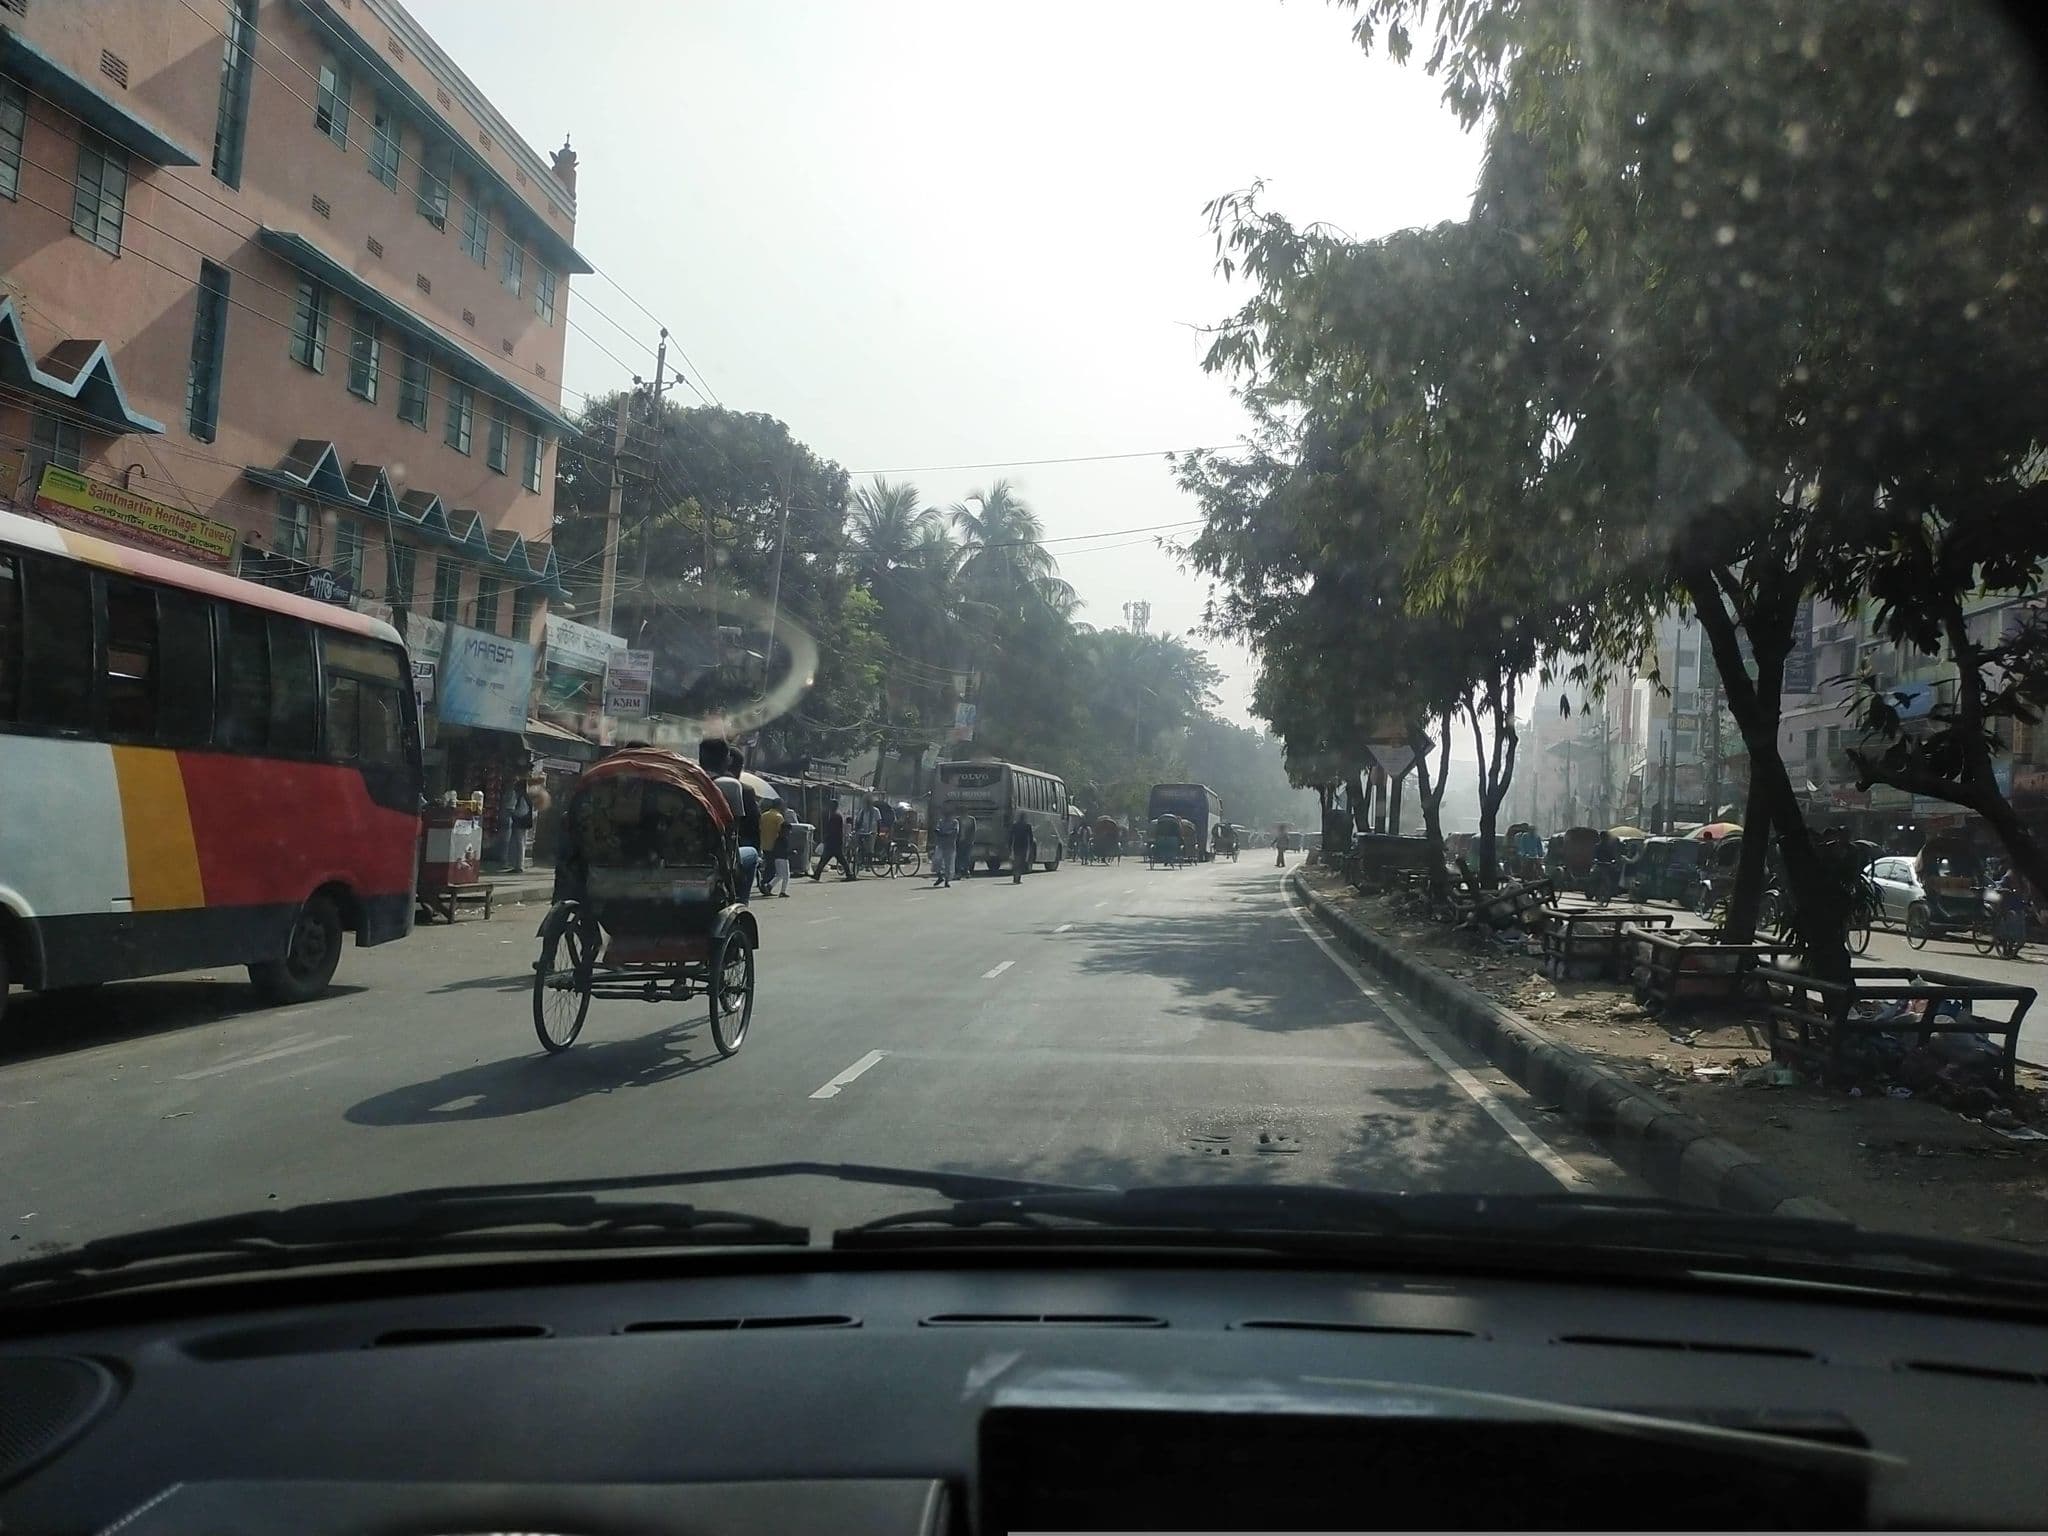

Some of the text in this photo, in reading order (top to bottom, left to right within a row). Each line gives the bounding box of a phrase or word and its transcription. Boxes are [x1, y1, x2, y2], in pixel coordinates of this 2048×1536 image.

[88, 484, 233, 544] Saintmartin Heritage Travels
